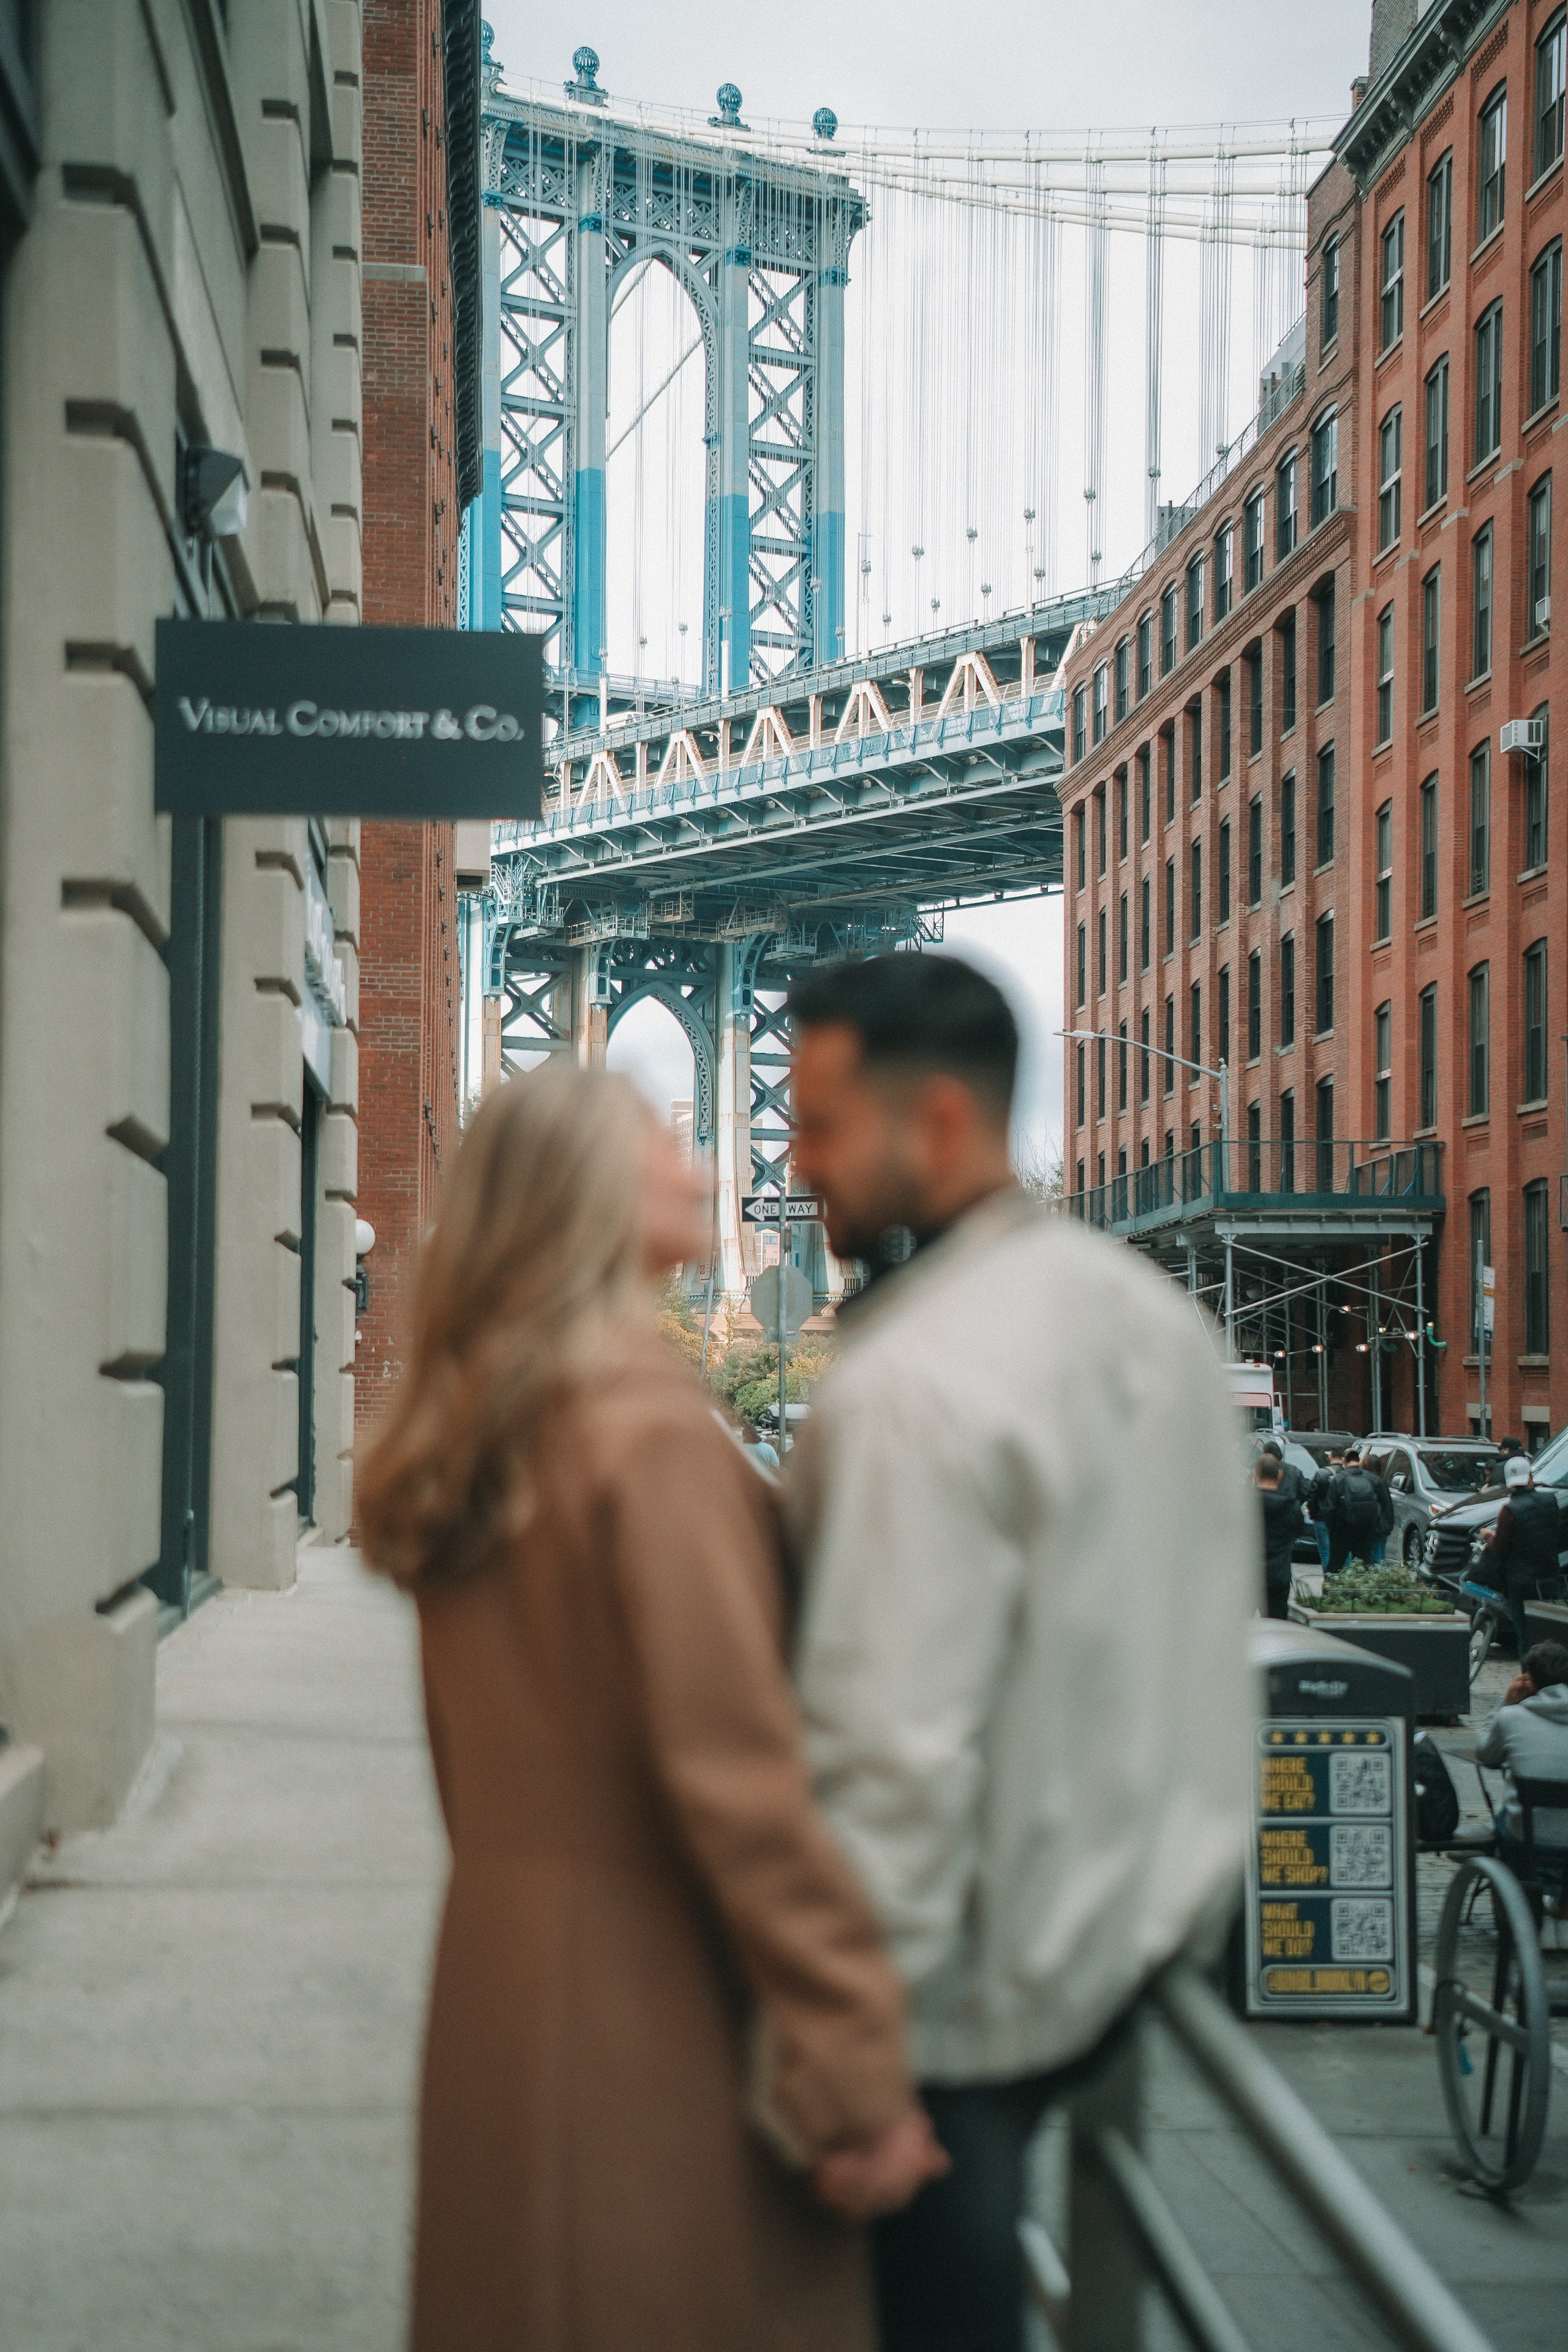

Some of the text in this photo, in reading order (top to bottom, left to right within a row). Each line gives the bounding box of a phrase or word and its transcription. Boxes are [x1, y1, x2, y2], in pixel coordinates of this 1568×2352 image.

[431, 709, 464, 740] &
[464, 704, 525, 741] CO.
[754, 1203, 813, 1215] ONE WAY
[1262, 1757, 1308, 1773] WHERE
[1262, 1774, 1313, 1791] SHOULD
[1262, 1792, 1315, 1810] WE EAT?
[1261, 1830, 1308, 1846] WHERE
[1262, 1848, 1314, 1864] SHOULD
[1262, 1866, 1328, 1883] WE SHOP?
[1262, 1903, 1298, 1919] WHAT
[1262, 1920, 1315, 1937] SHOULD
[1263, 1938, 1313, 1955] WE DO?
